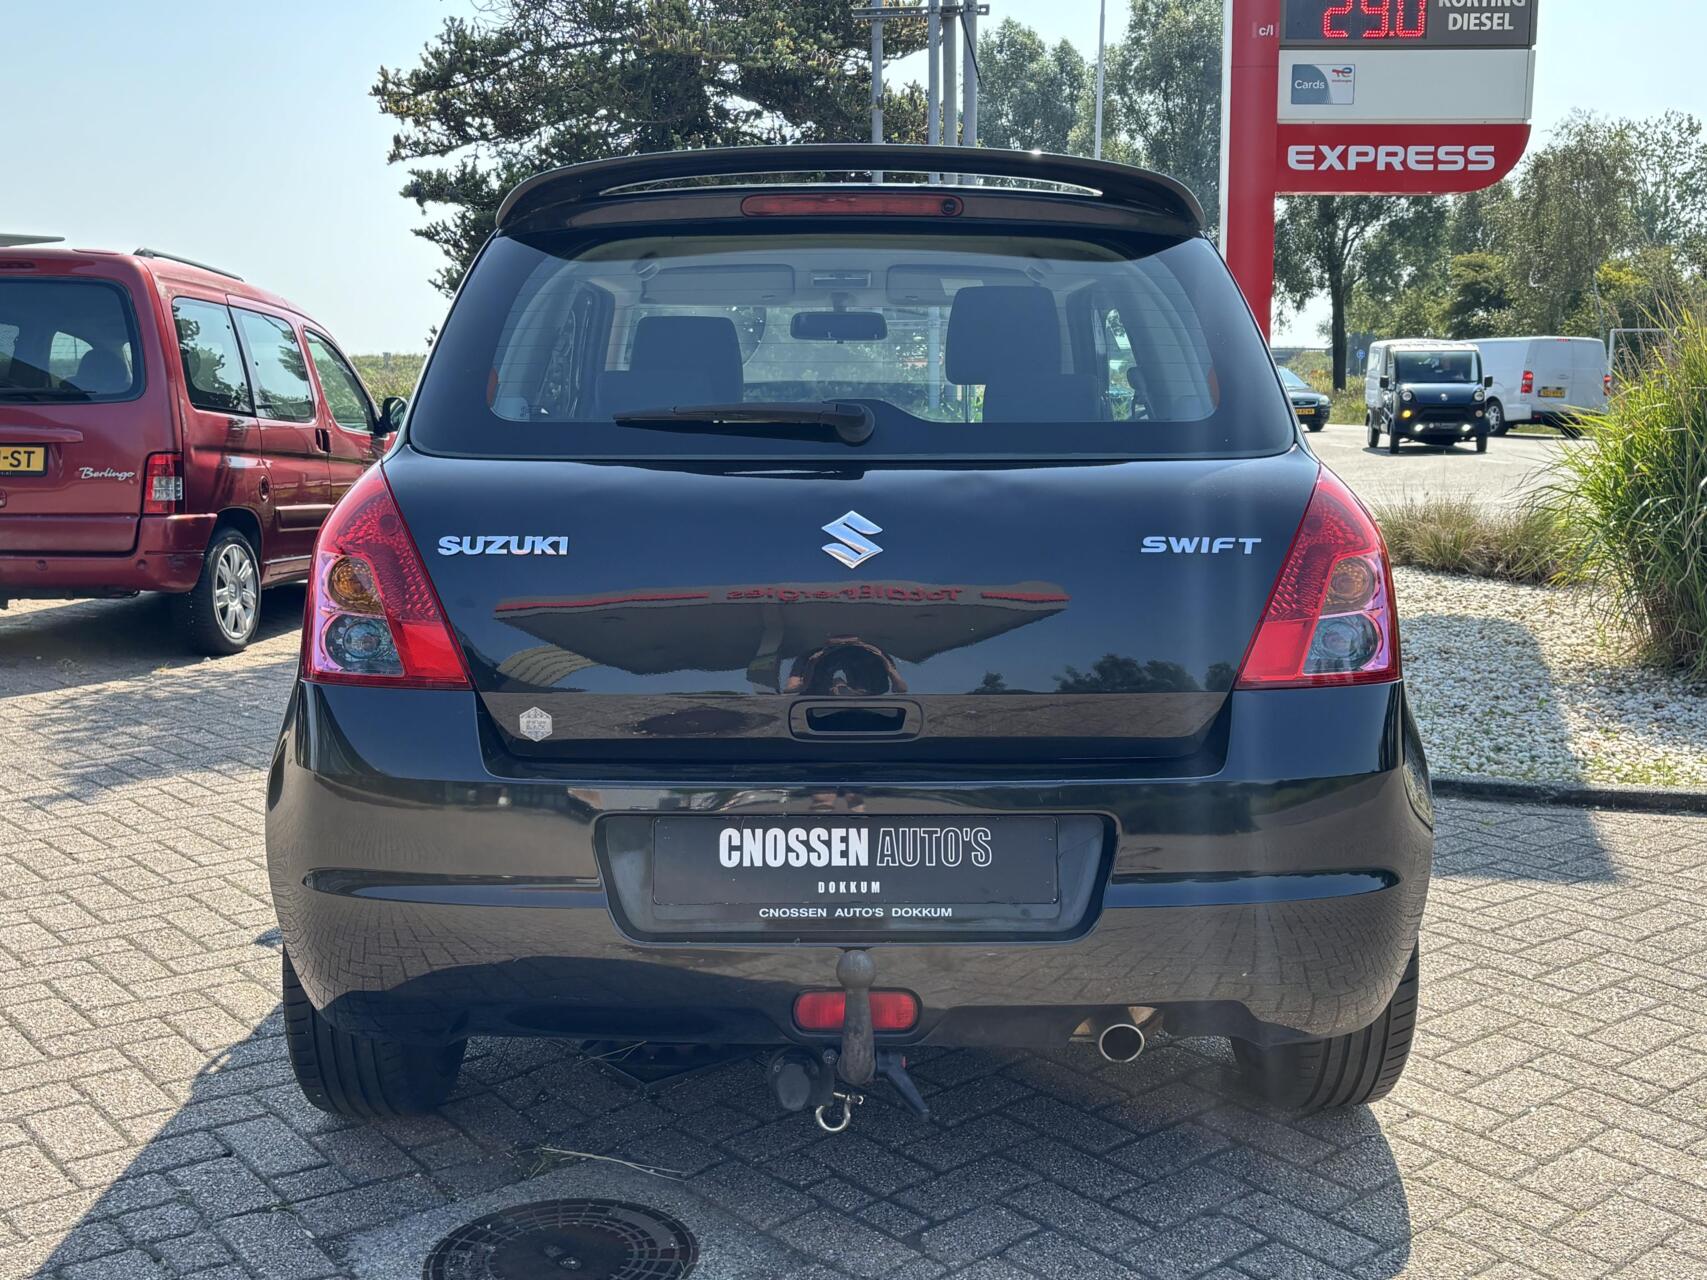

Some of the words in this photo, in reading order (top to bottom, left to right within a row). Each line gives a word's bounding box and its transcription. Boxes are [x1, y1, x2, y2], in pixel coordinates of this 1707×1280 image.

[1322, 0, 1426, 38] 29.0
[1447, 12, 1514, 31] DIESEL
[1294, 79, 1325, 90] Cards
[1287, 145, 1495, 171] EXPRESS
[0, 449, 36, 468] -ST
[79, 466, 135, 481] Berlingo
[437, 535, 569, 556] SUZUKI
[1140, 536, 1262, 555] SWIFT
[719, 827, 869, 868] CNOSSEN
[876, 827, 993, 868] AUTO'S
[817, 881, 881, 894] DOKKUM
[758, 907, 827, 918] CNOSSEN
[835, 907, 884, 918] AUTO'S
[891, 907, 953, 918] DOKKUM
